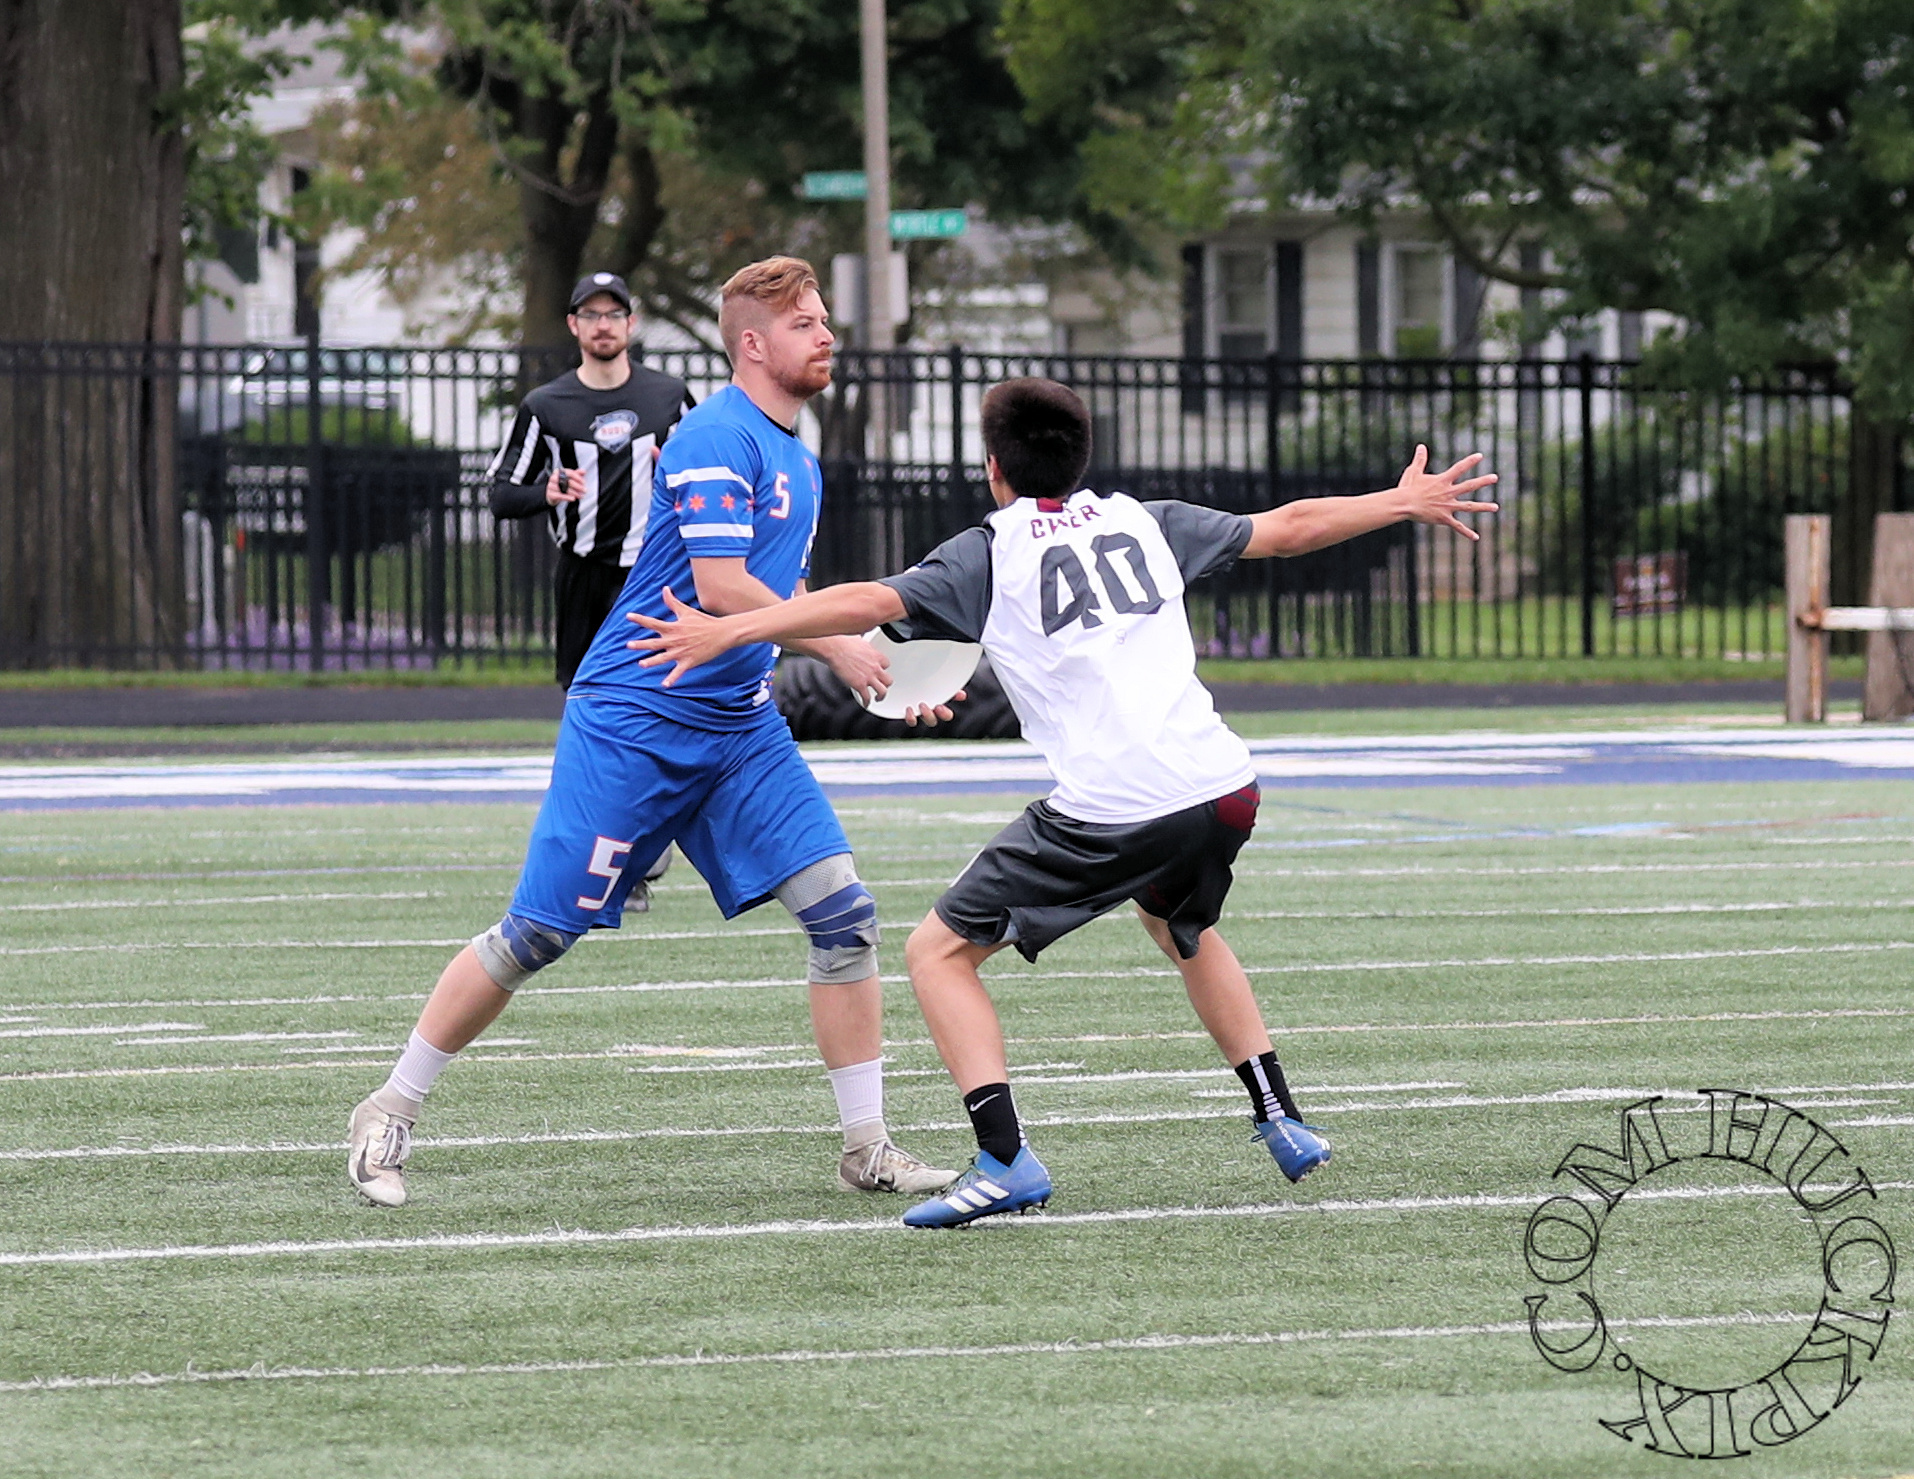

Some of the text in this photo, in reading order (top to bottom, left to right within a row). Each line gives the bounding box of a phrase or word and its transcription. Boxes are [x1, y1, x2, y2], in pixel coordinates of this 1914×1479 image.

[769, 471, 790, 519] 5
[1040, 532, 1166, 637] 40
[576, 834, 634, 911] 5
